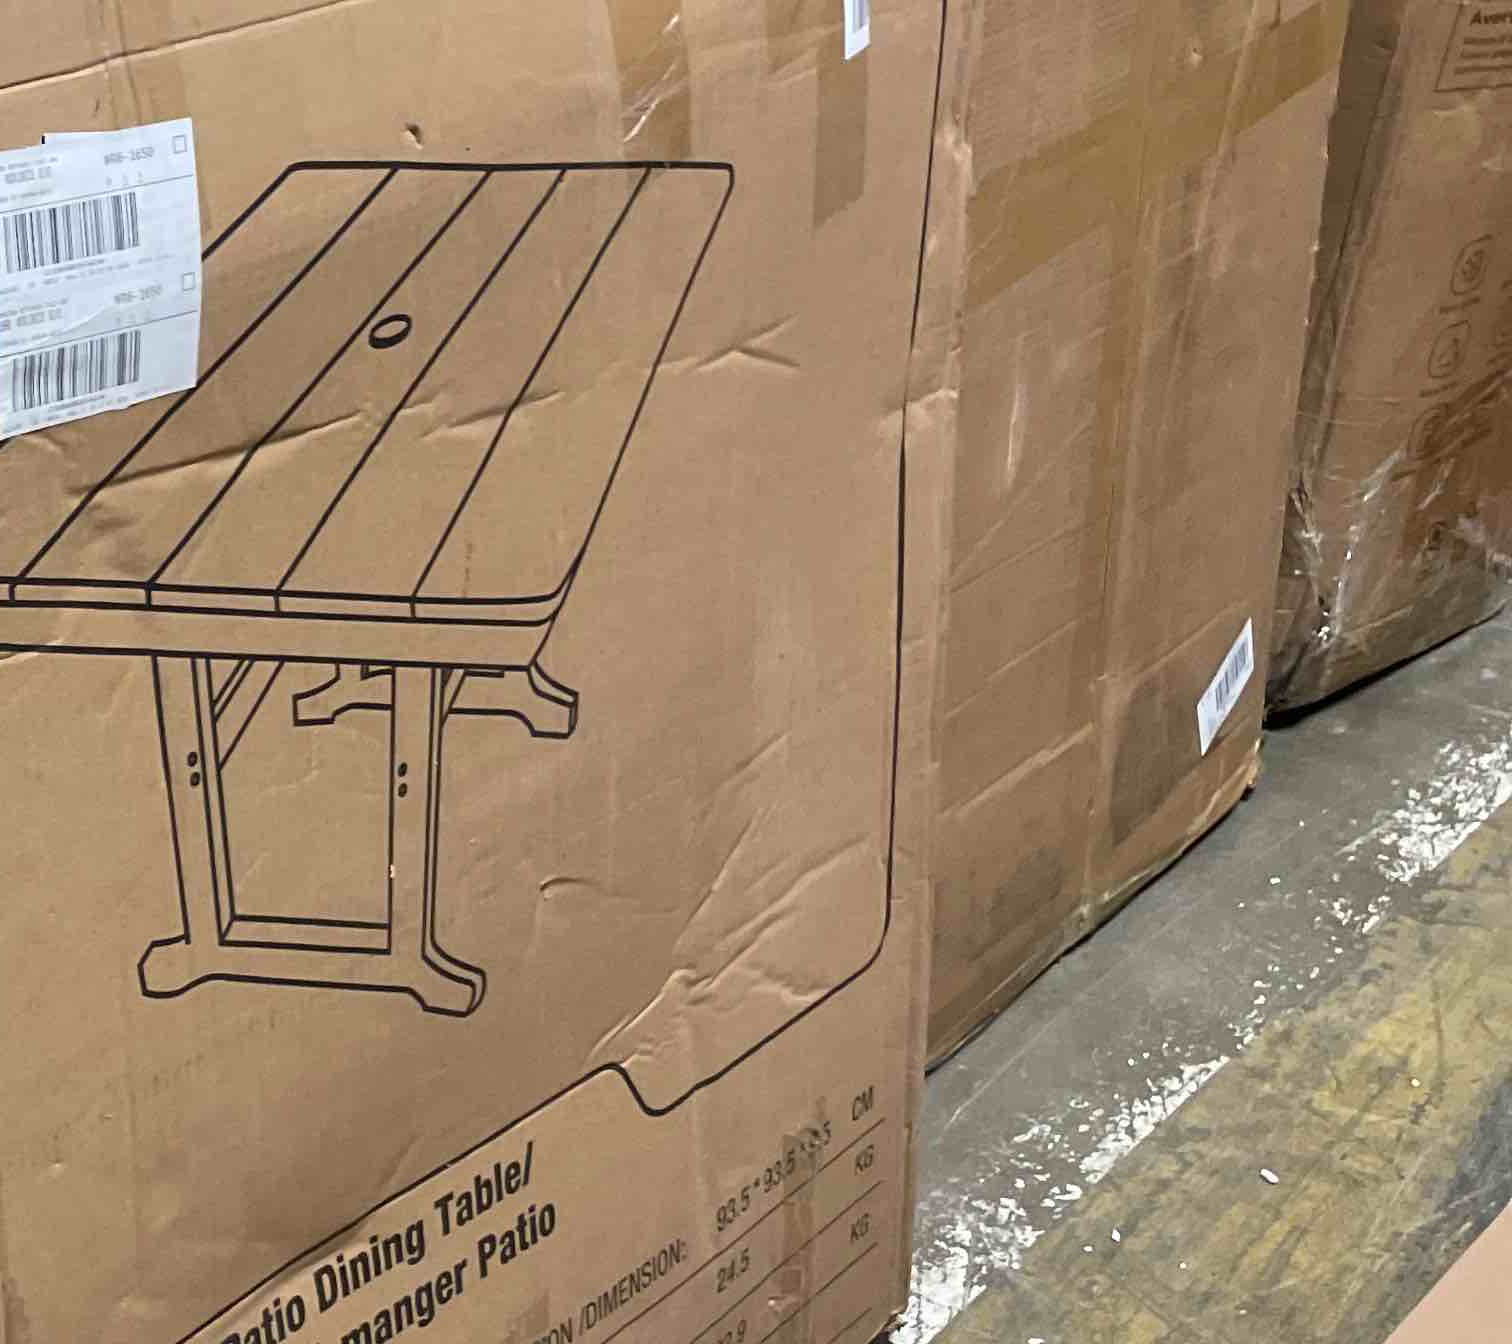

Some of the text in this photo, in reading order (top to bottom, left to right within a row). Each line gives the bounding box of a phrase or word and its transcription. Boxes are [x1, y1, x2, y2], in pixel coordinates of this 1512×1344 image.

[312, 1218, 428, 1315] Dining
[433, 1140, 535, 1237] Table/
[476, 1201, 557, 1280] Patio
[578, 1237, 687, 1337] /DIMENSION:
[850, 1084, 875, 1122] CM
[716, 1247, 751, 1294] 24.5
[854, 1143, 875, 1177] KG
[849, 1212, 871, 1245] KG
